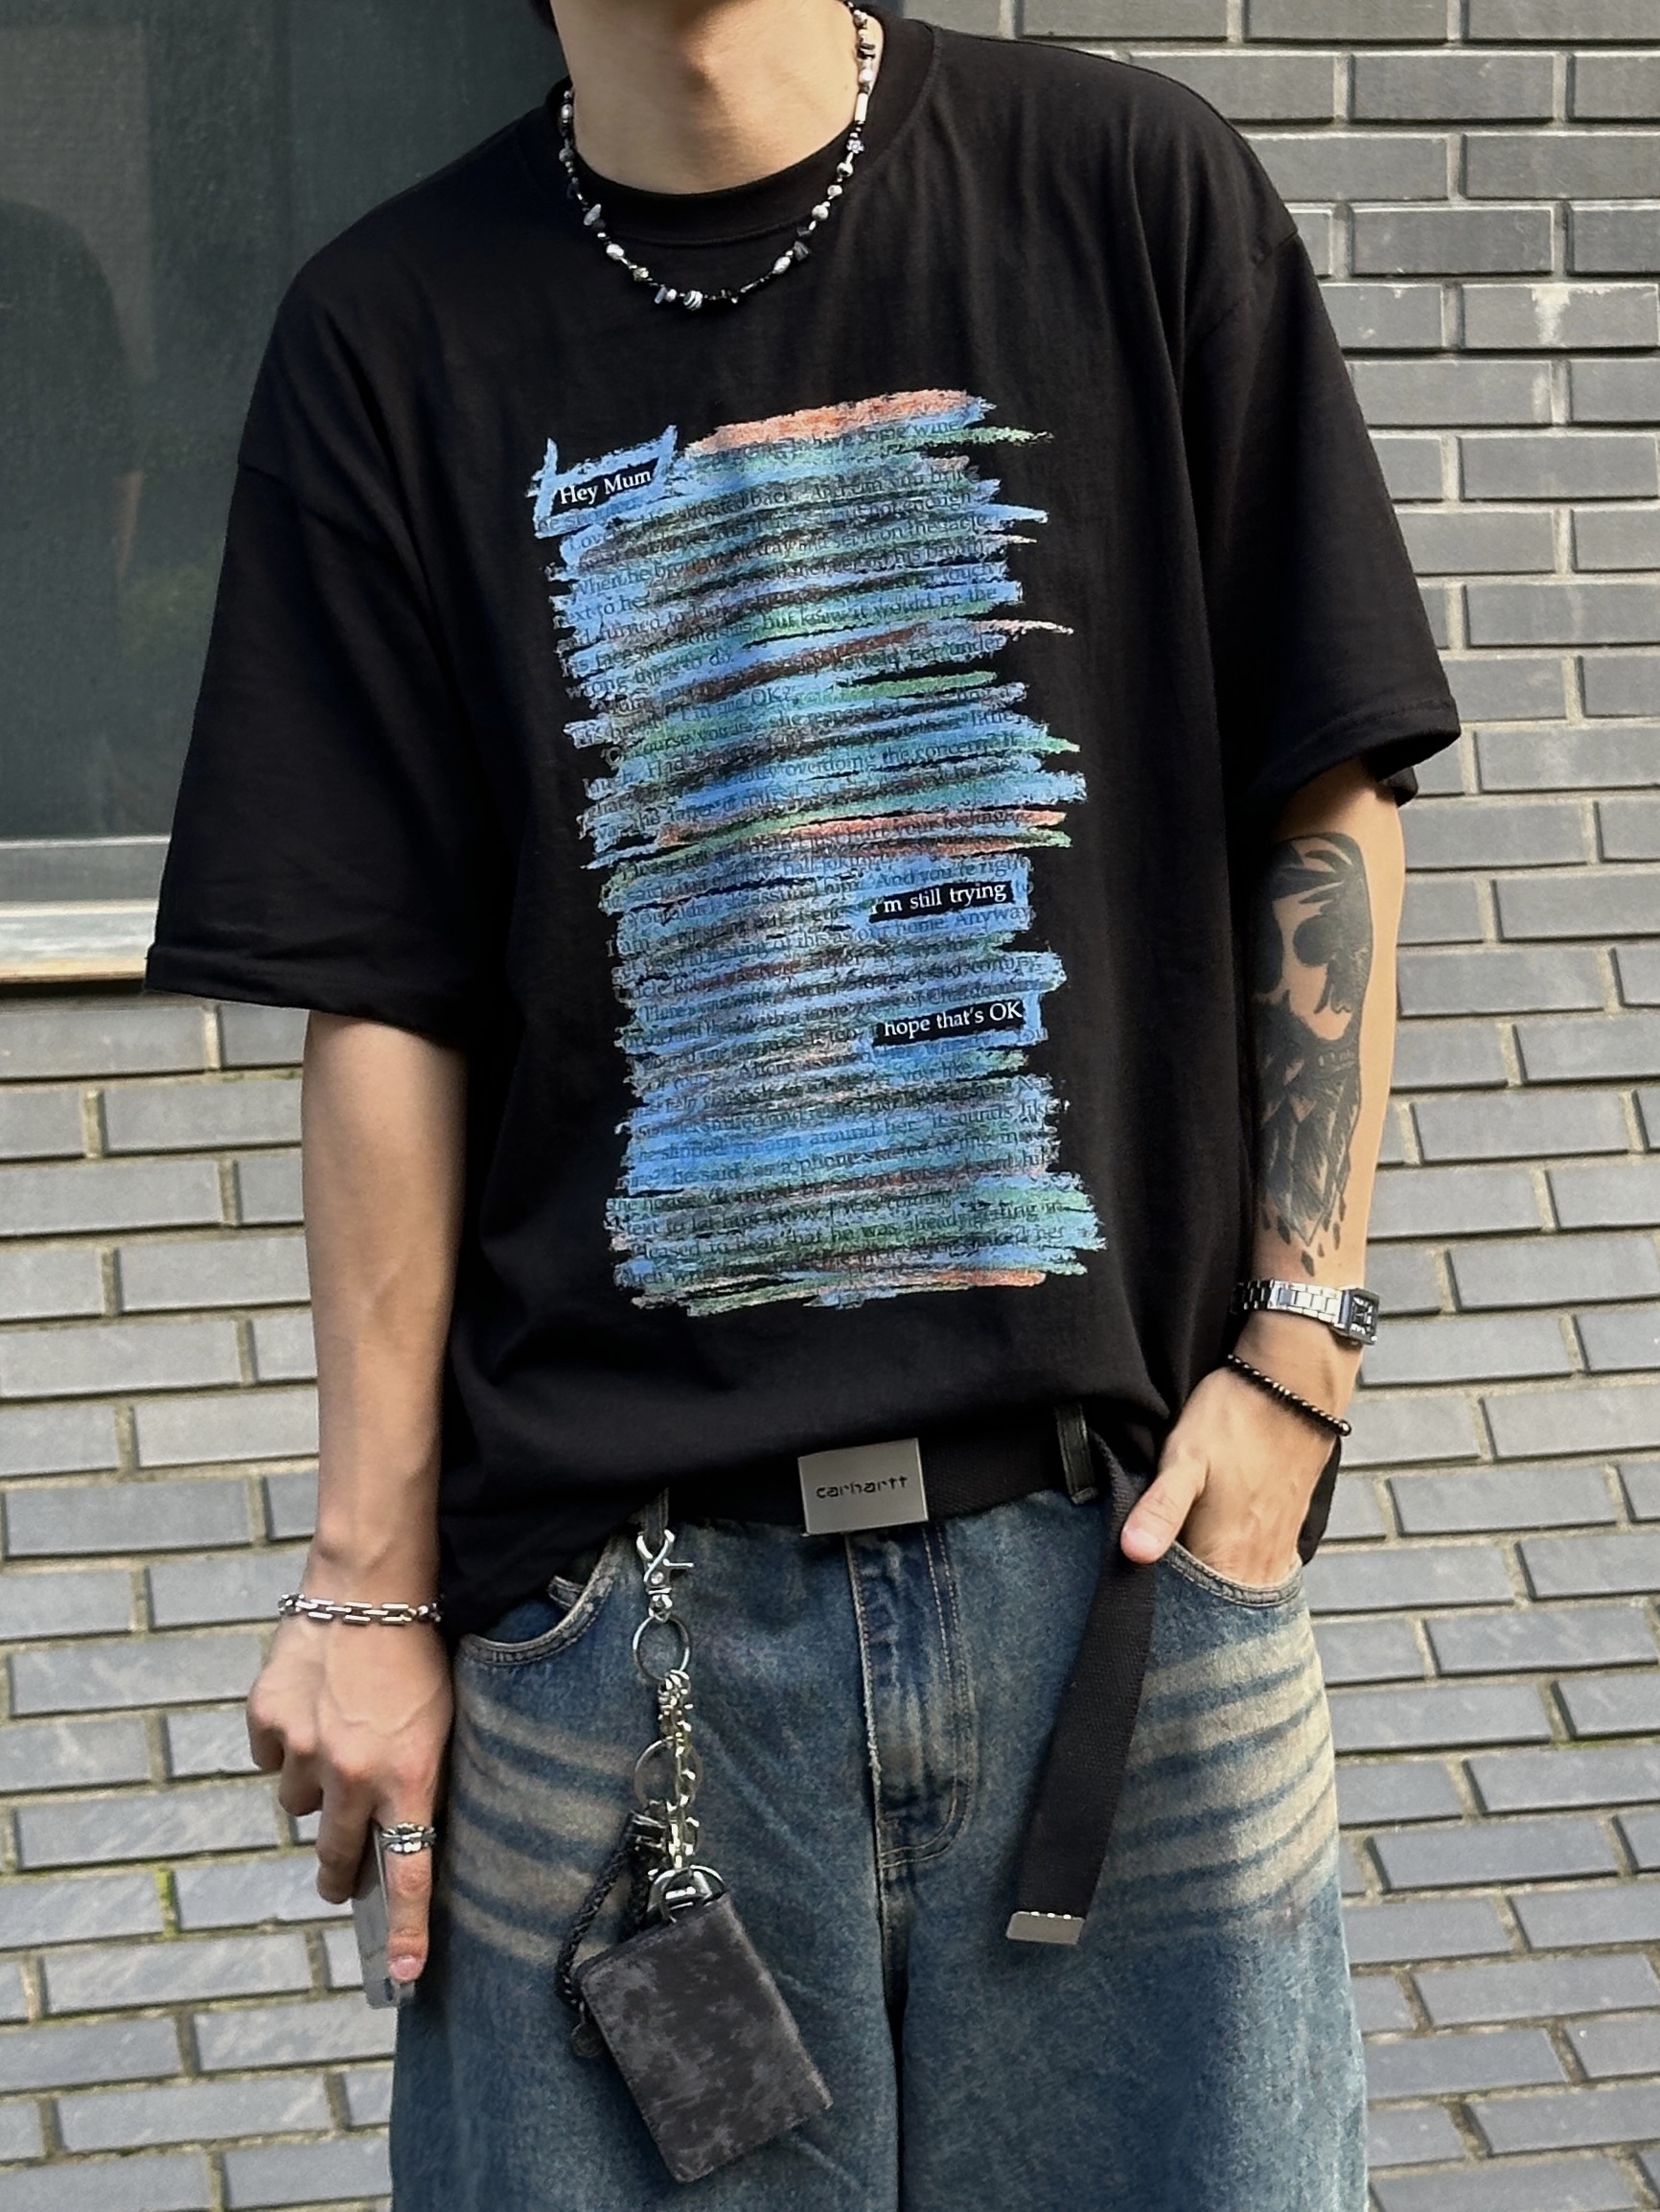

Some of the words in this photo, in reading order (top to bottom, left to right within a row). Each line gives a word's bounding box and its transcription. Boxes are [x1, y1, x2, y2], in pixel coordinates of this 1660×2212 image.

[560, 485, 599, 505] Hey
[604, 472, 653, 495] Mum
[910, 887, 943, 910] still
[949, 882, 1007, 908] trying
[884, 1018, 931, 1040] hope
[936, 1006, 984, 1030] that's
[989, 1001, 1024, 1022] OK
[817, 1475, 909, 1499] carhartt
